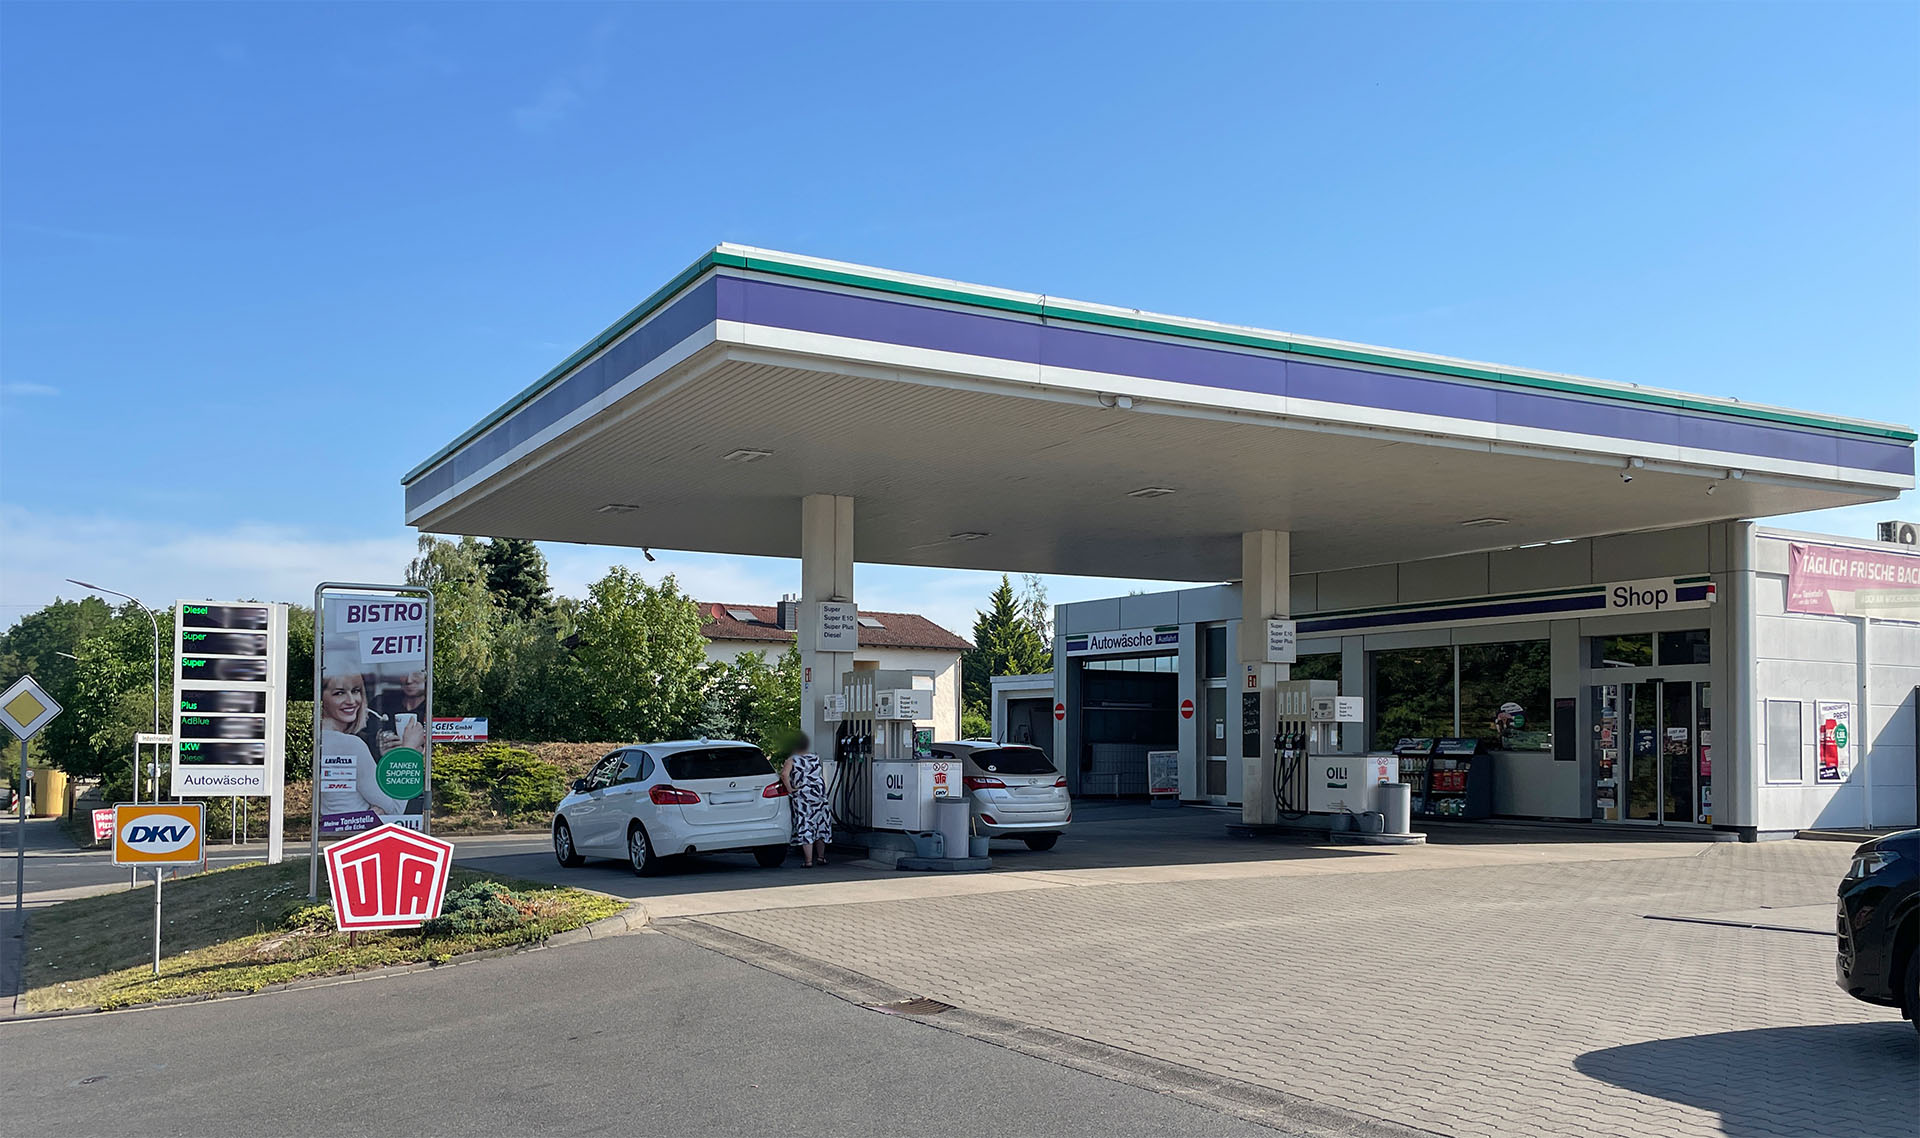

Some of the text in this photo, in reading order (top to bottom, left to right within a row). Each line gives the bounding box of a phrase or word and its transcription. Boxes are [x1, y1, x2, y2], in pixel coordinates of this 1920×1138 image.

[1802, 552, 1848, 577] TÄGLICH
[1849, 560, 1896, 582] FRISCHE
[1613, 586, 1668, 609] Shop
[183, 605, 208, 615] Diesel
[347, 603, 423, 623] BISTRO
[823, 605, 841, 613] Super
[823, 614, 841, 622] Super
[823, 623, 854, 631] Super Plus
[183, 631, 207, 642] Super
[1090, 632, 1153, 650] Autowäsche
[371, 634, 422, 655] ZEIT!
[182, 657, 206, 669] Super
[180, 700, 198, 711] Plus
[181, 716, 210, 726] AdBlue
[180, 742, 200, 752] LKW
[386, 769, 420, 777] SHOPPEN
[1326, 767, 1348, 780] OIL!
[184, 774, 260, 786] Autowäsche
[386, 777, 420, 785] SNACKEN
[886, 774, 903, 789] OIL!
[340, 815, 374, 825] Tankstelle
[127, 825, 191, 843] DKV
[340, 836, 438, 917] UTA
